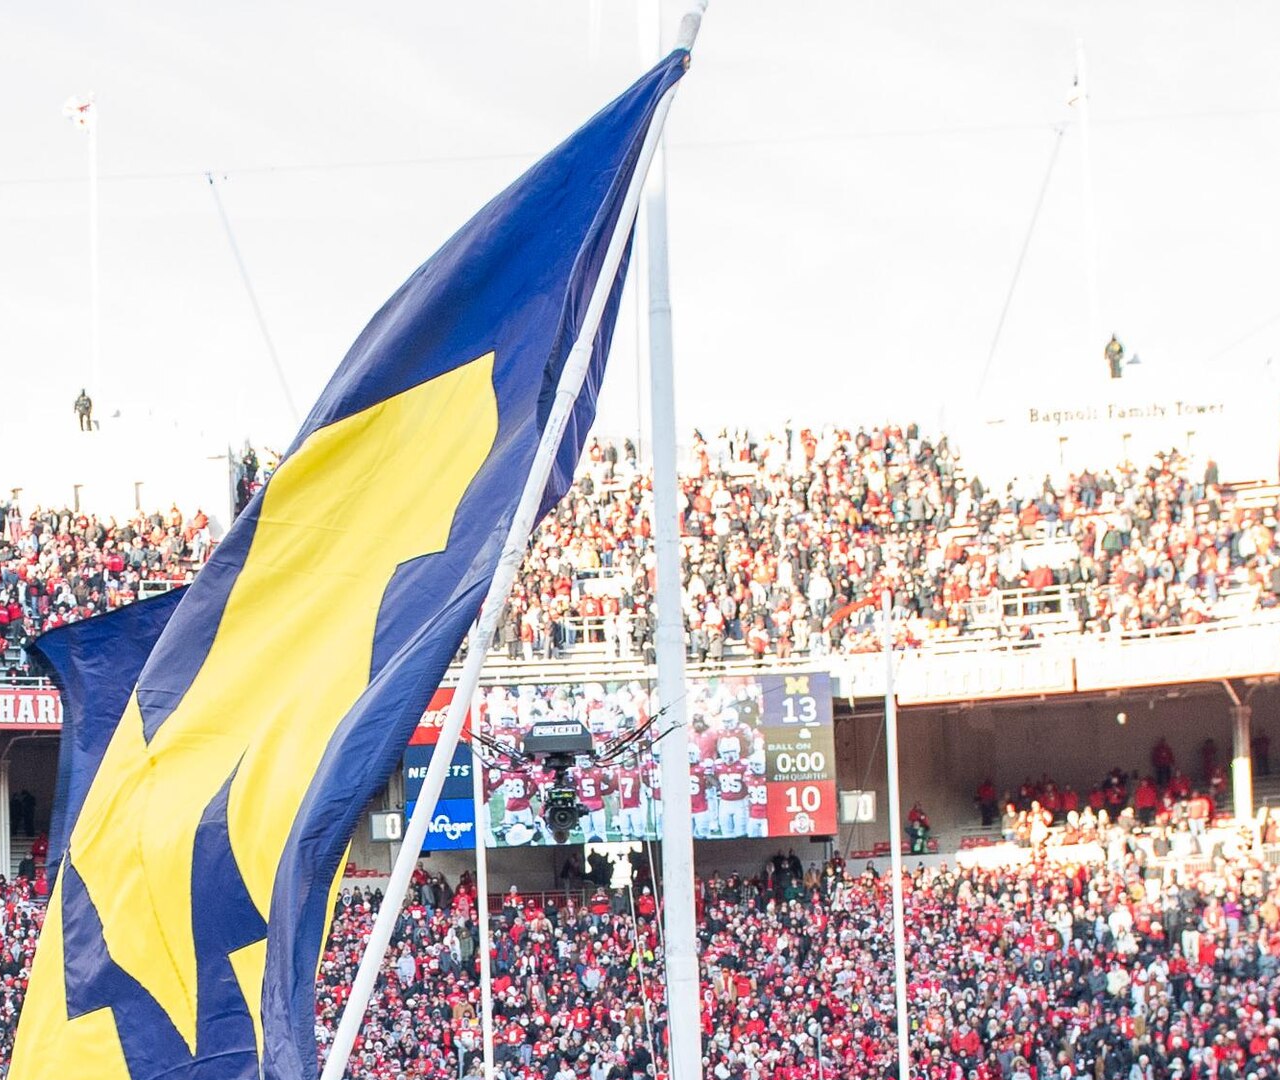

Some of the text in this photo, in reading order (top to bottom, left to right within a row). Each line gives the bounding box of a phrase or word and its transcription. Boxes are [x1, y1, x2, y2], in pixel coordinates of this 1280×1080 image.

[781, 697, 818, 724] 13
[776, 751, 825, 773] 0:00
[785, 786, 821, 813] 10
